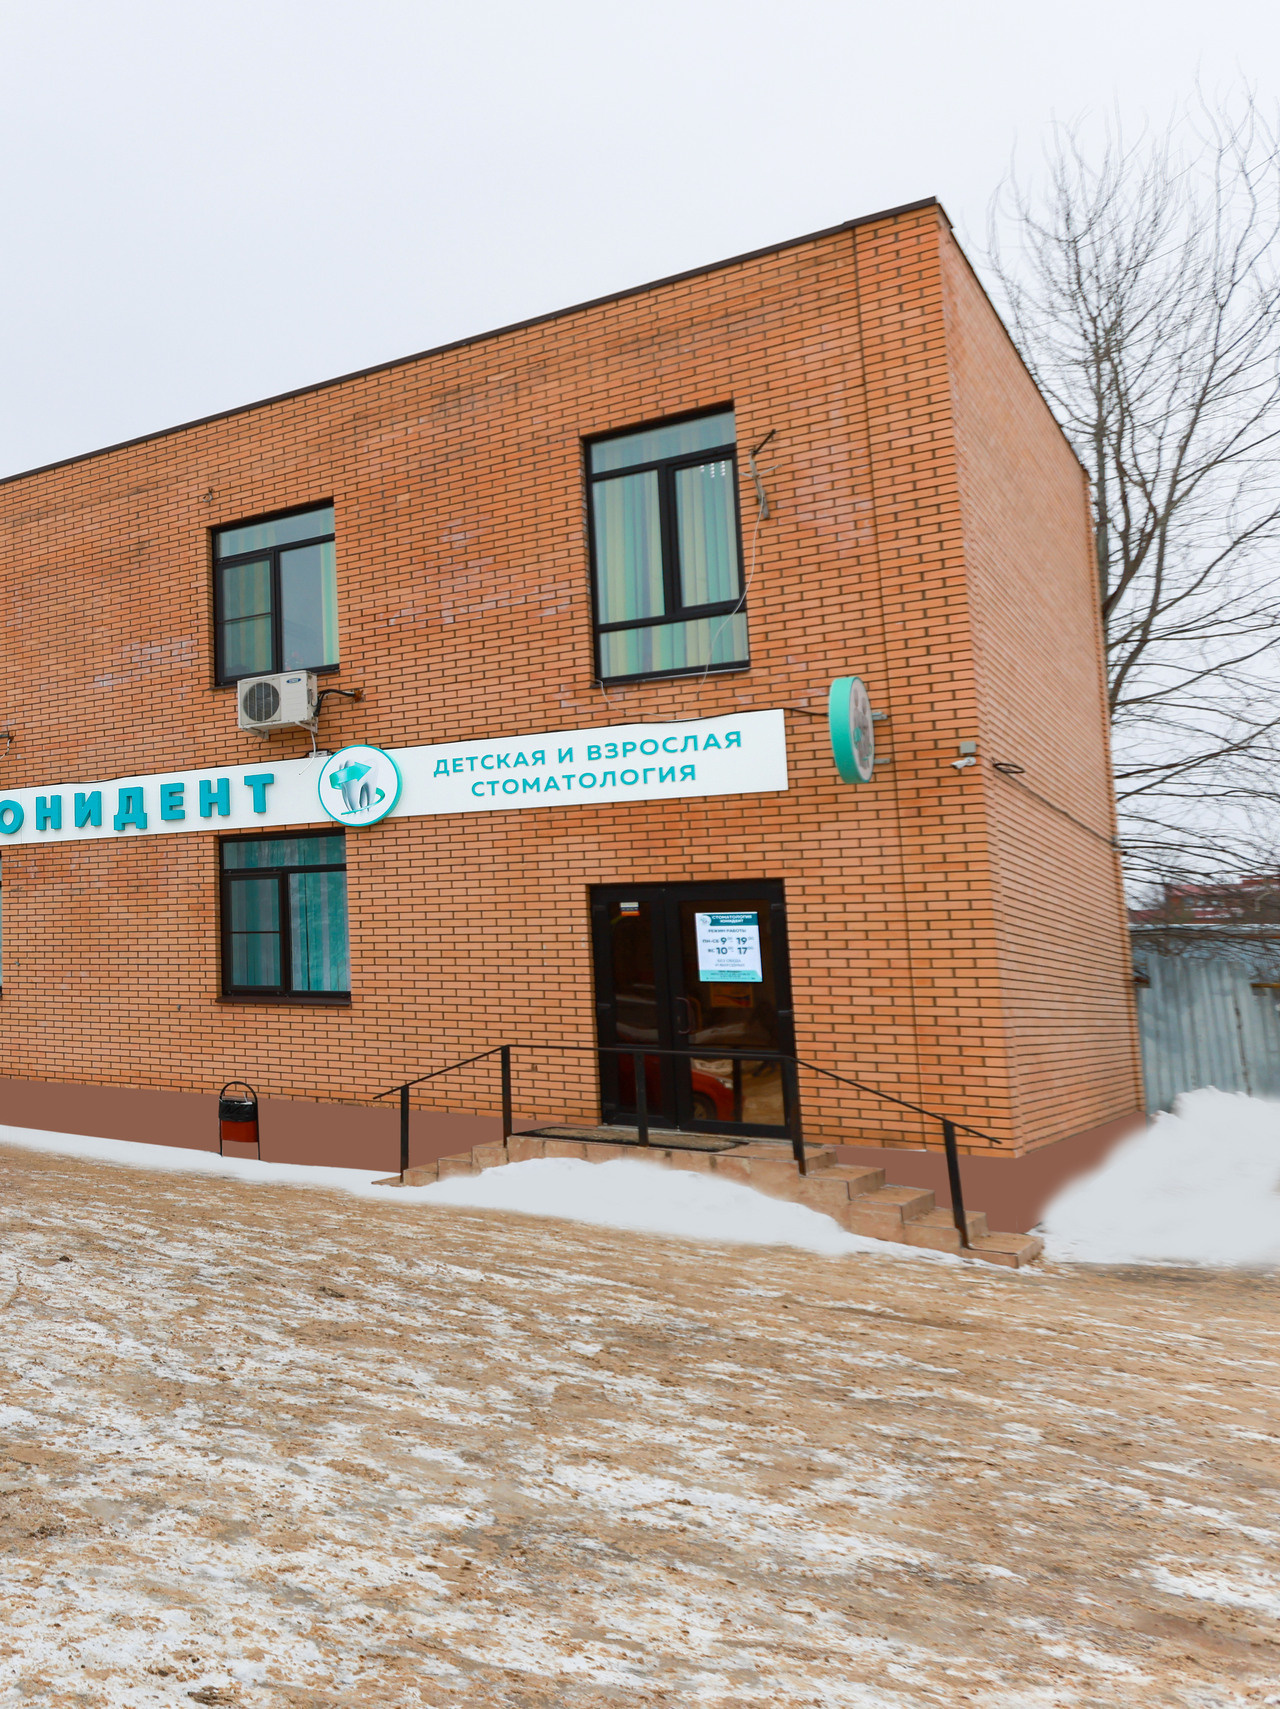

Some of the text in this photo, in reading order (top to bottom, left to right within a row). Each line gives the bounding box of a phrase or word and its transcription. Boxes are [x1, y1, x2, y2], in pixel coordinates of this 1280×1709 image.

[433, 730, 742, 778] ДЕТСКАЯ И ВЗРОСЛАЯ
[471, 764, 696, 797] СТОМАТОЛОГИЯ
[716, 947, 728, 955] 10
[737, 947, 747, 955] 17
[720, 937, 727, 945] 9
[736, 937, 747, 945] 19
